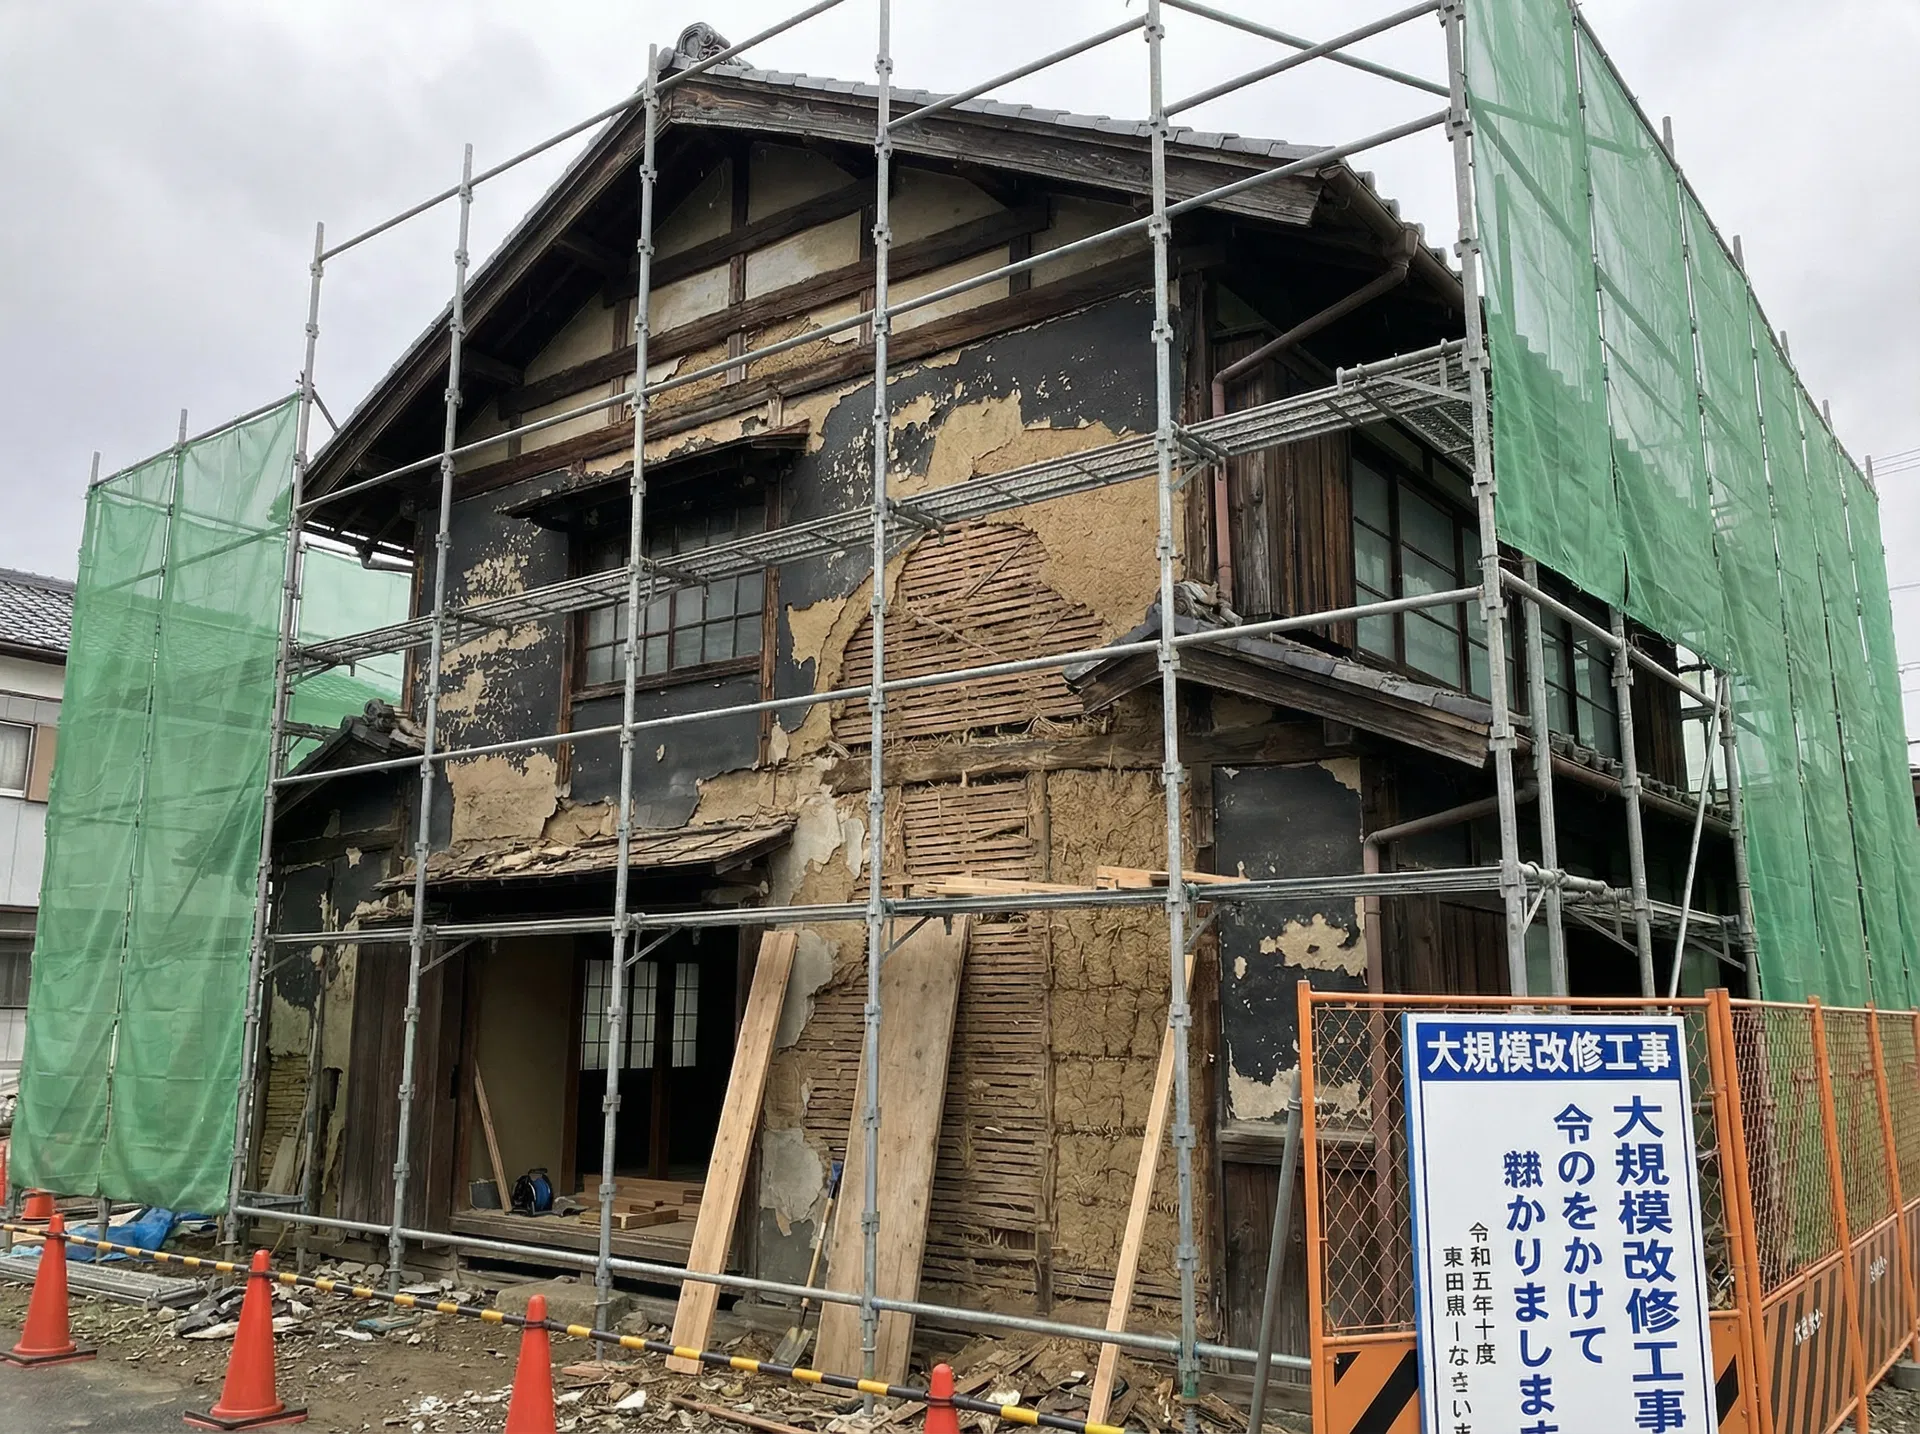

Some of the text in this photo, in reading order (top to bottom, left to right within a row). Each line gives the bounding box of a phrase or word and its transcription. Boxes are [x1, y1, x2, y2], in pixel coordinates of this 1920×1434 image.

[1427, 1031, 1671, 1074] 大規模改修工事
[1469, 1222, 1496, 1365] 令和五年十度
[1554, 1103, 1605, 1364] 令のをかけて
[1614, 1095, 1686, 1433] 大規模改修工事
